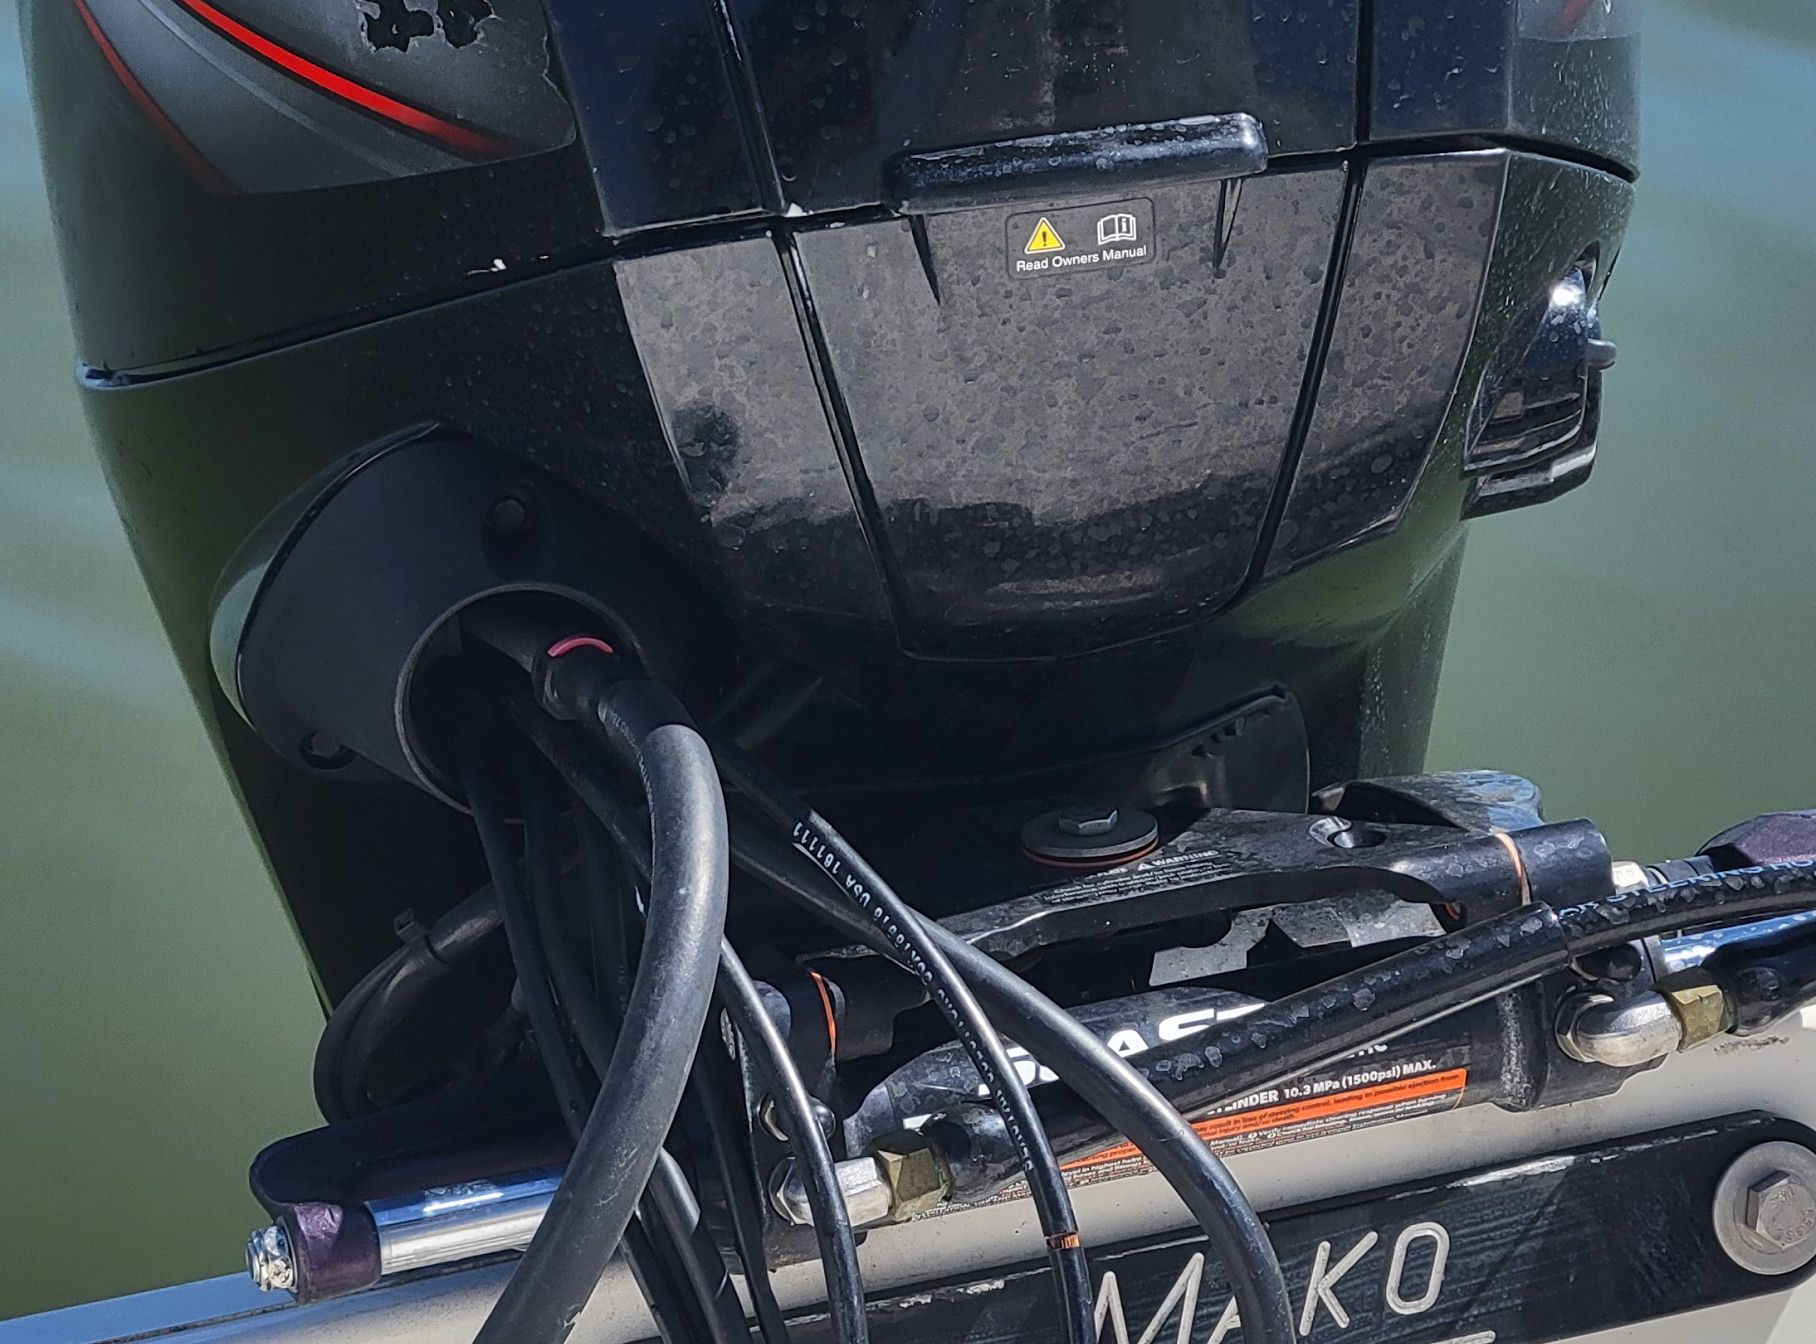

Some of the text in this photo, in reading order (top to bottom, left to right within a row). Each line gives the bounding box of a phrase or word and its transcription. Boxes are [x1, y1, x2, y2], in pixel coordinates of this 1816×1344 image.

[1016, 245, 1147, 272] Read Owners Manual
[845, 874, 872, 908] USA
[1284, 1084, 1312, 1099] 10.3
[1313, 1080, 1340, 1094] MPa
[1342, 1066, 1400, 1089] (1500psi)
[1402, 1059, 1437, 1075] MAX.
